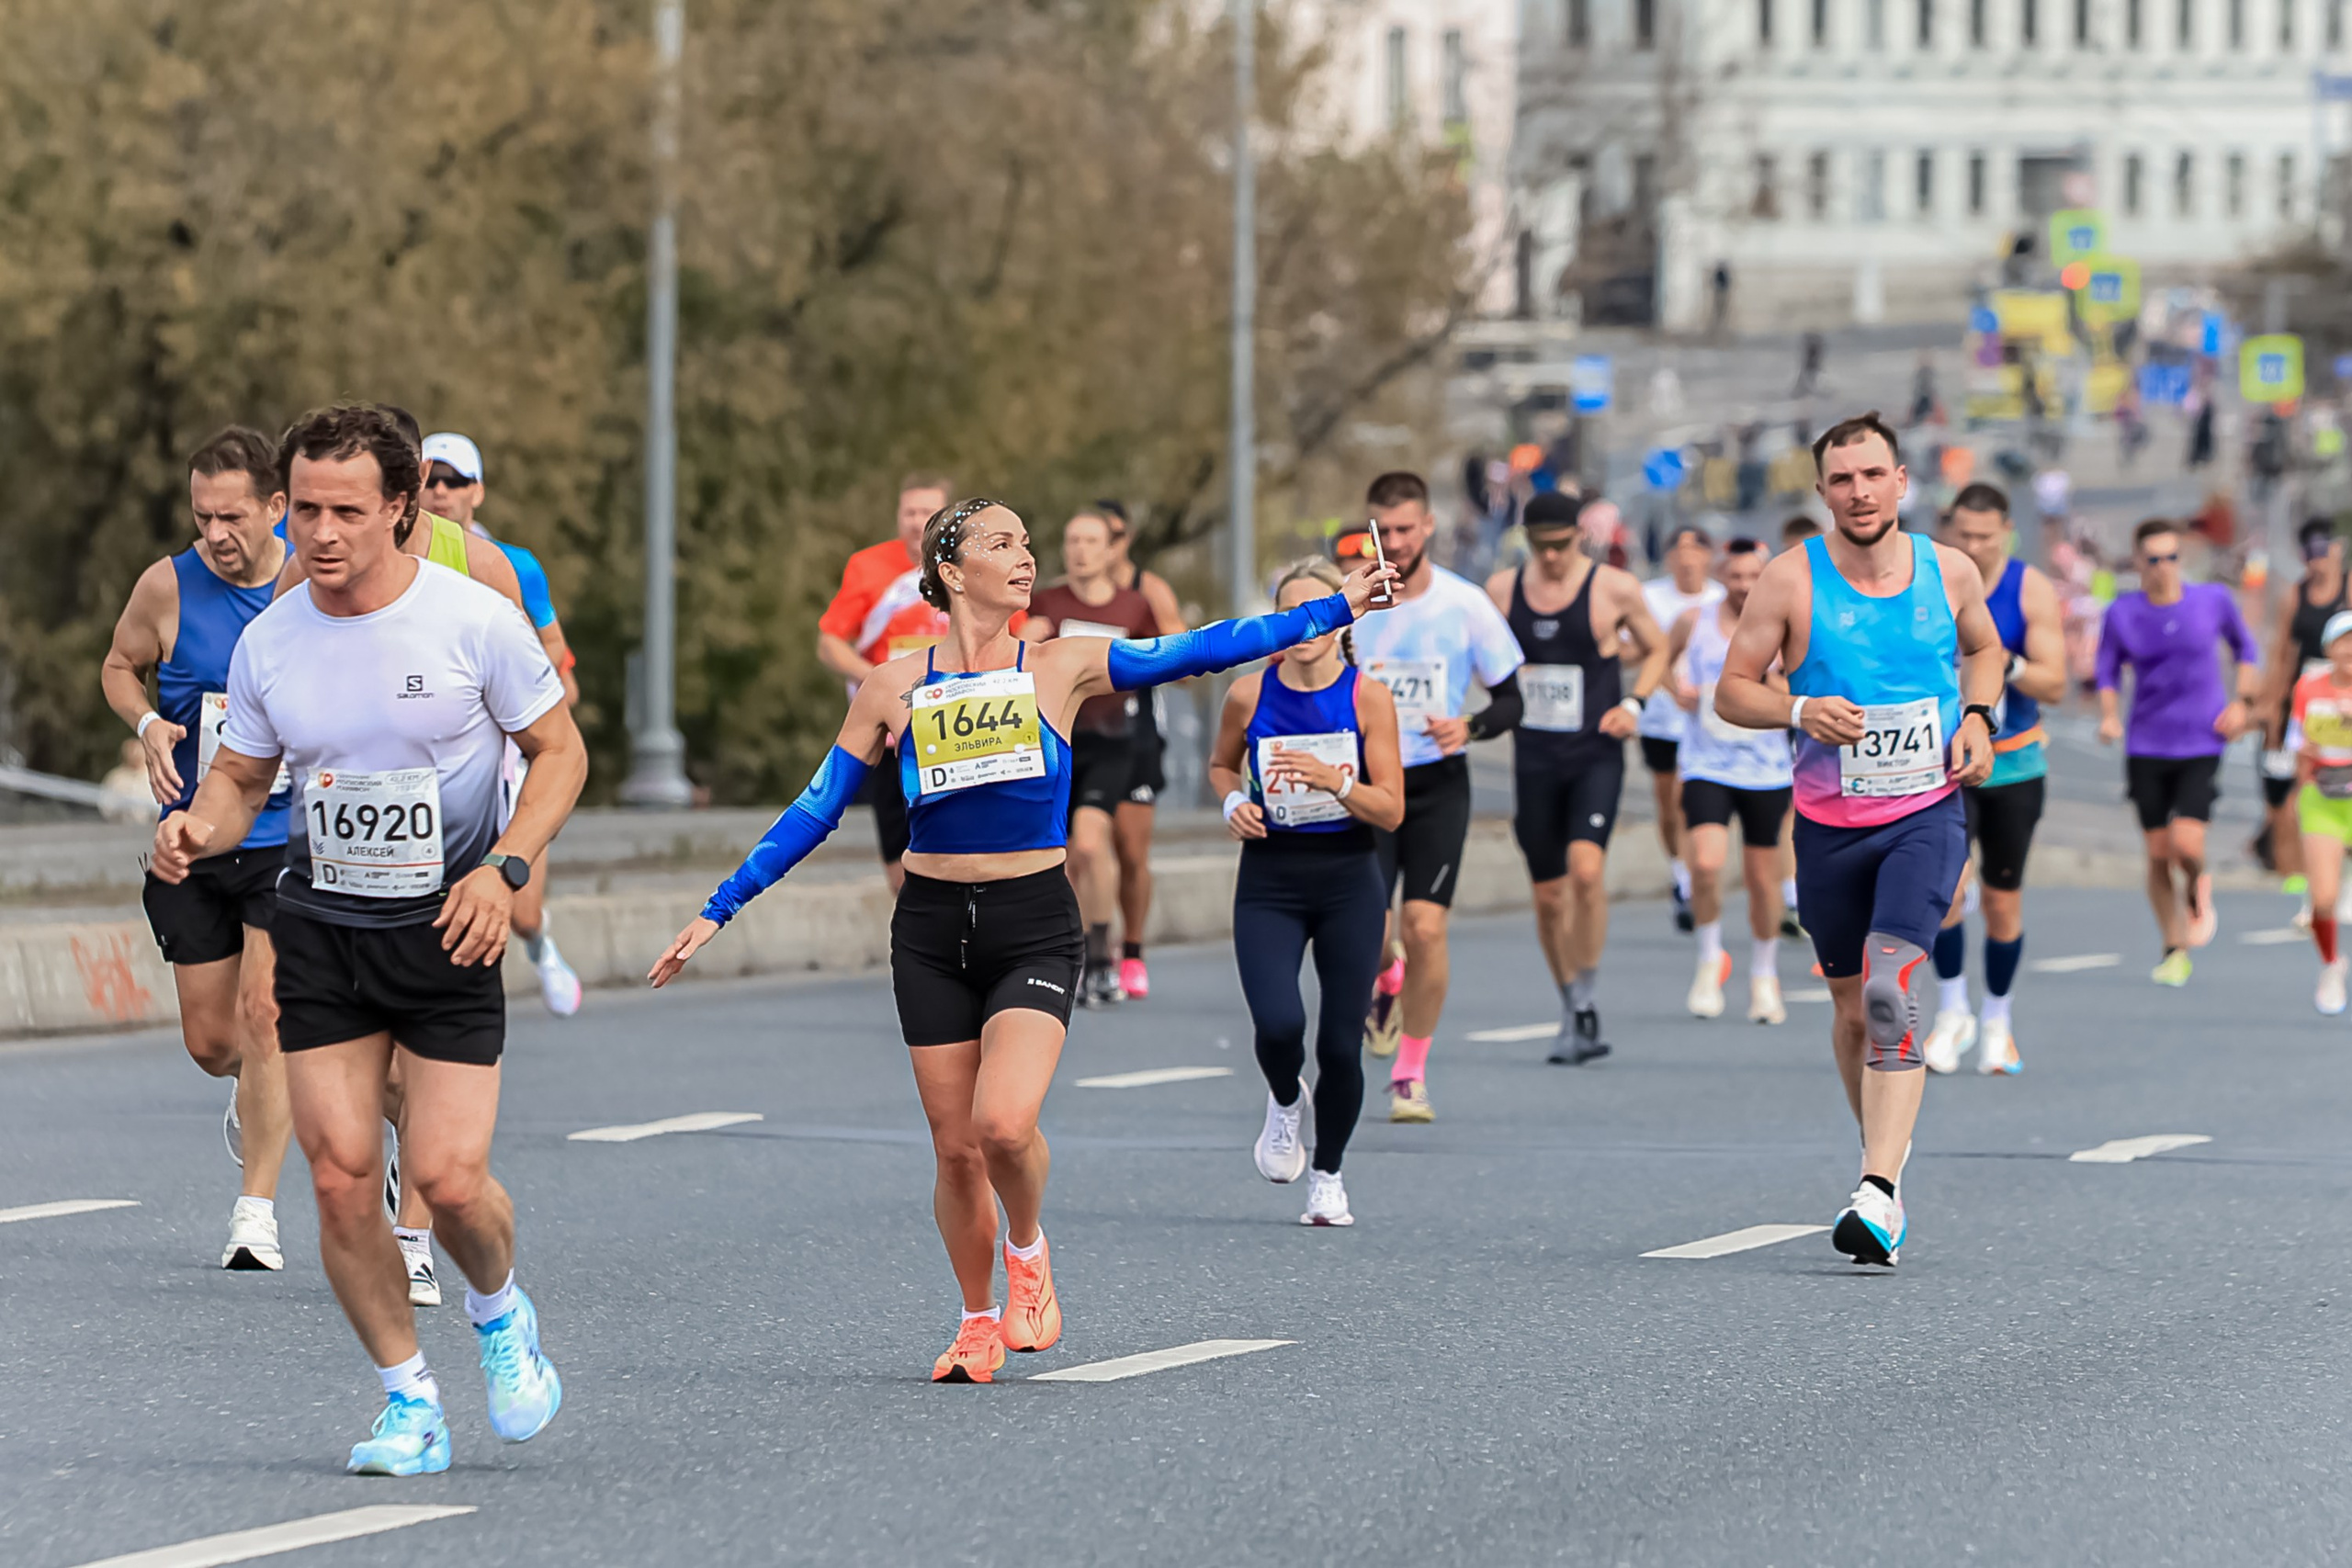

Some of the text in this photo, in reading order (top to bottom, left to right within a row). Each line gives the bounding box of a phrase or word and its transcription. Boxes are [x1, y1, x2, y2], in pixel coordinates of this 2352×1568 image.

[932, 700, 1023, 740] 1644
[954, 737, 1002, 751] ЭЛЬВИРА
[1852, 722, 1934, 758] 13741
[932, 767, 946, 787] D
[311, 800, 433, 841] 16920
[346, 845, 395, 857] АЛЕКСЕЙ
[322, 863, 337, 885] D
